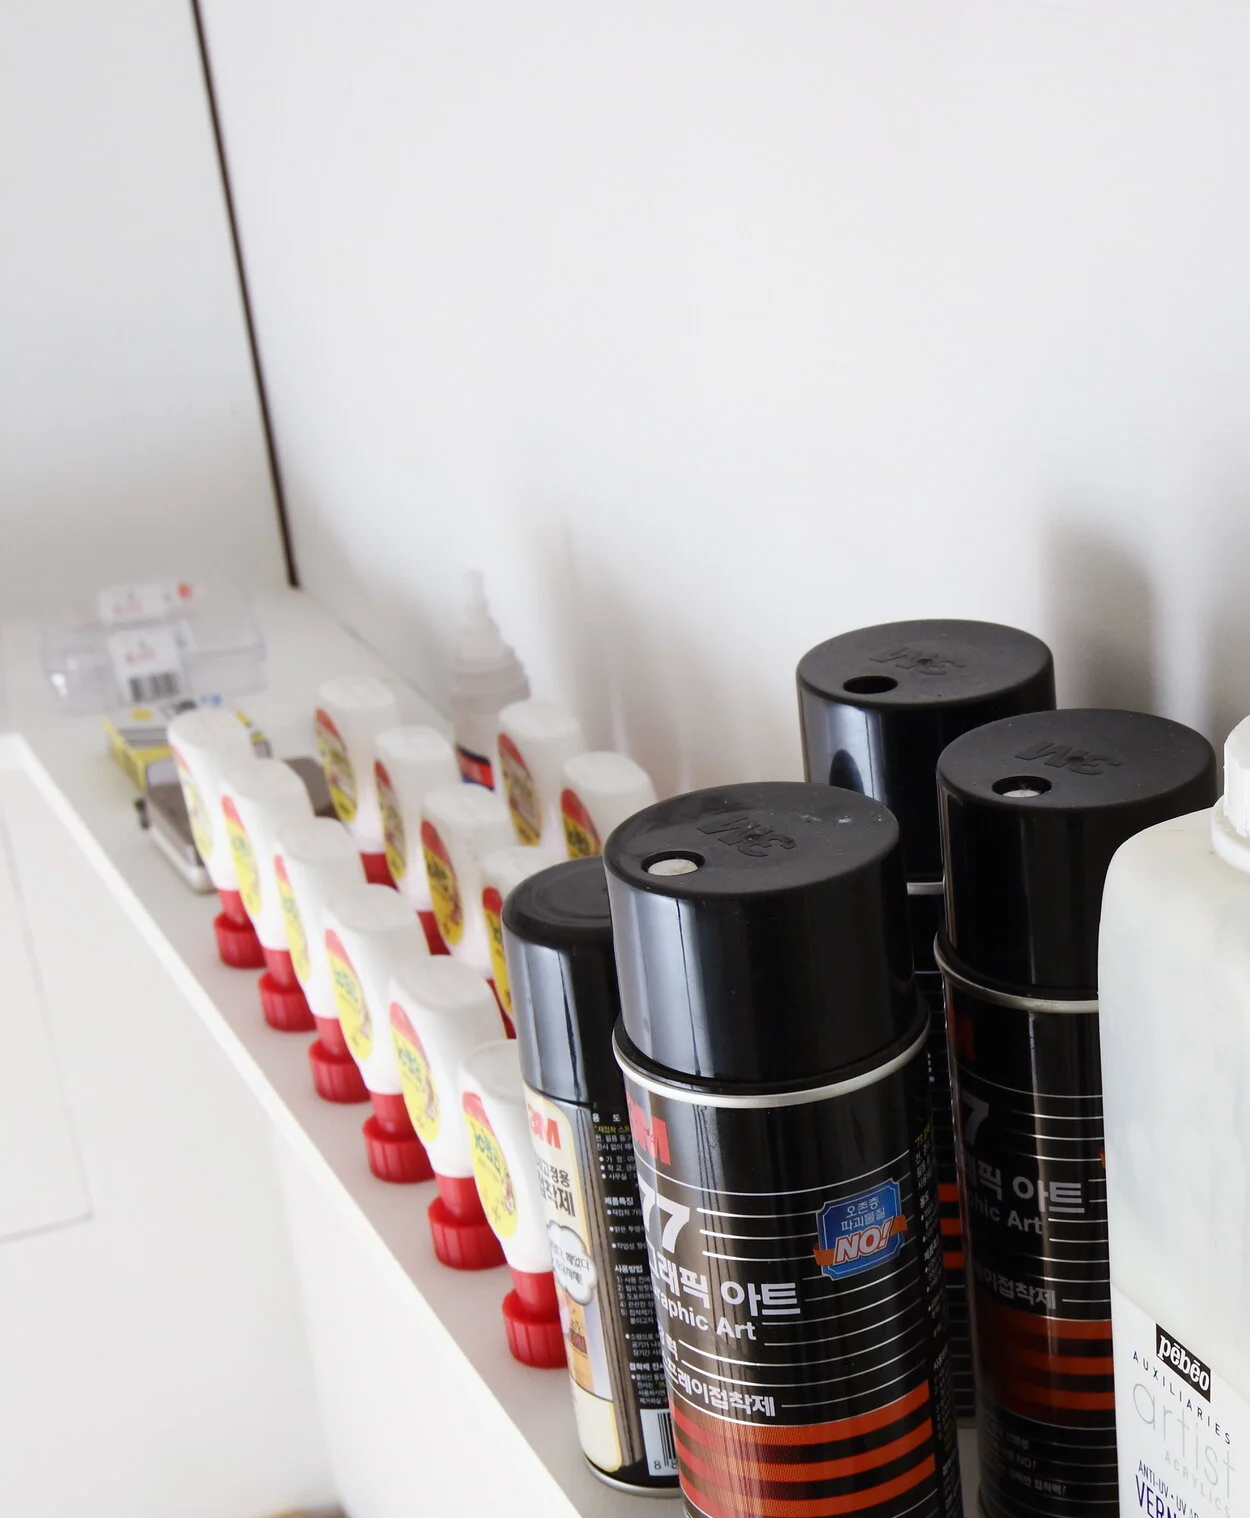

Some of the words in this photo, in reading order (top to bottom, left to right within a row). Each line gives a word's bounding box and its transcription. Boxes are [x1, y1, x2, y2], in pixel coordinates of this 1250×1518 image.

[846, 1196, 879, 1219] 오존층
[1012, 1176, 1085, 1214] 아트
[833, 1216, 895, 1264] NO!
[1007, 1211, 1043, 1236] Art
[720, 1281, 801, 1317] 아트
[716, 1317, 757, 1341] Art
[1132, 1351, 1231, 1445] AUXILIARIES
[1133, 1383, 1235, 1499] artist
[1138, 1459, 1169, 1498] ANTI-UV
[1176, 1494, 1187, 1515] UV
